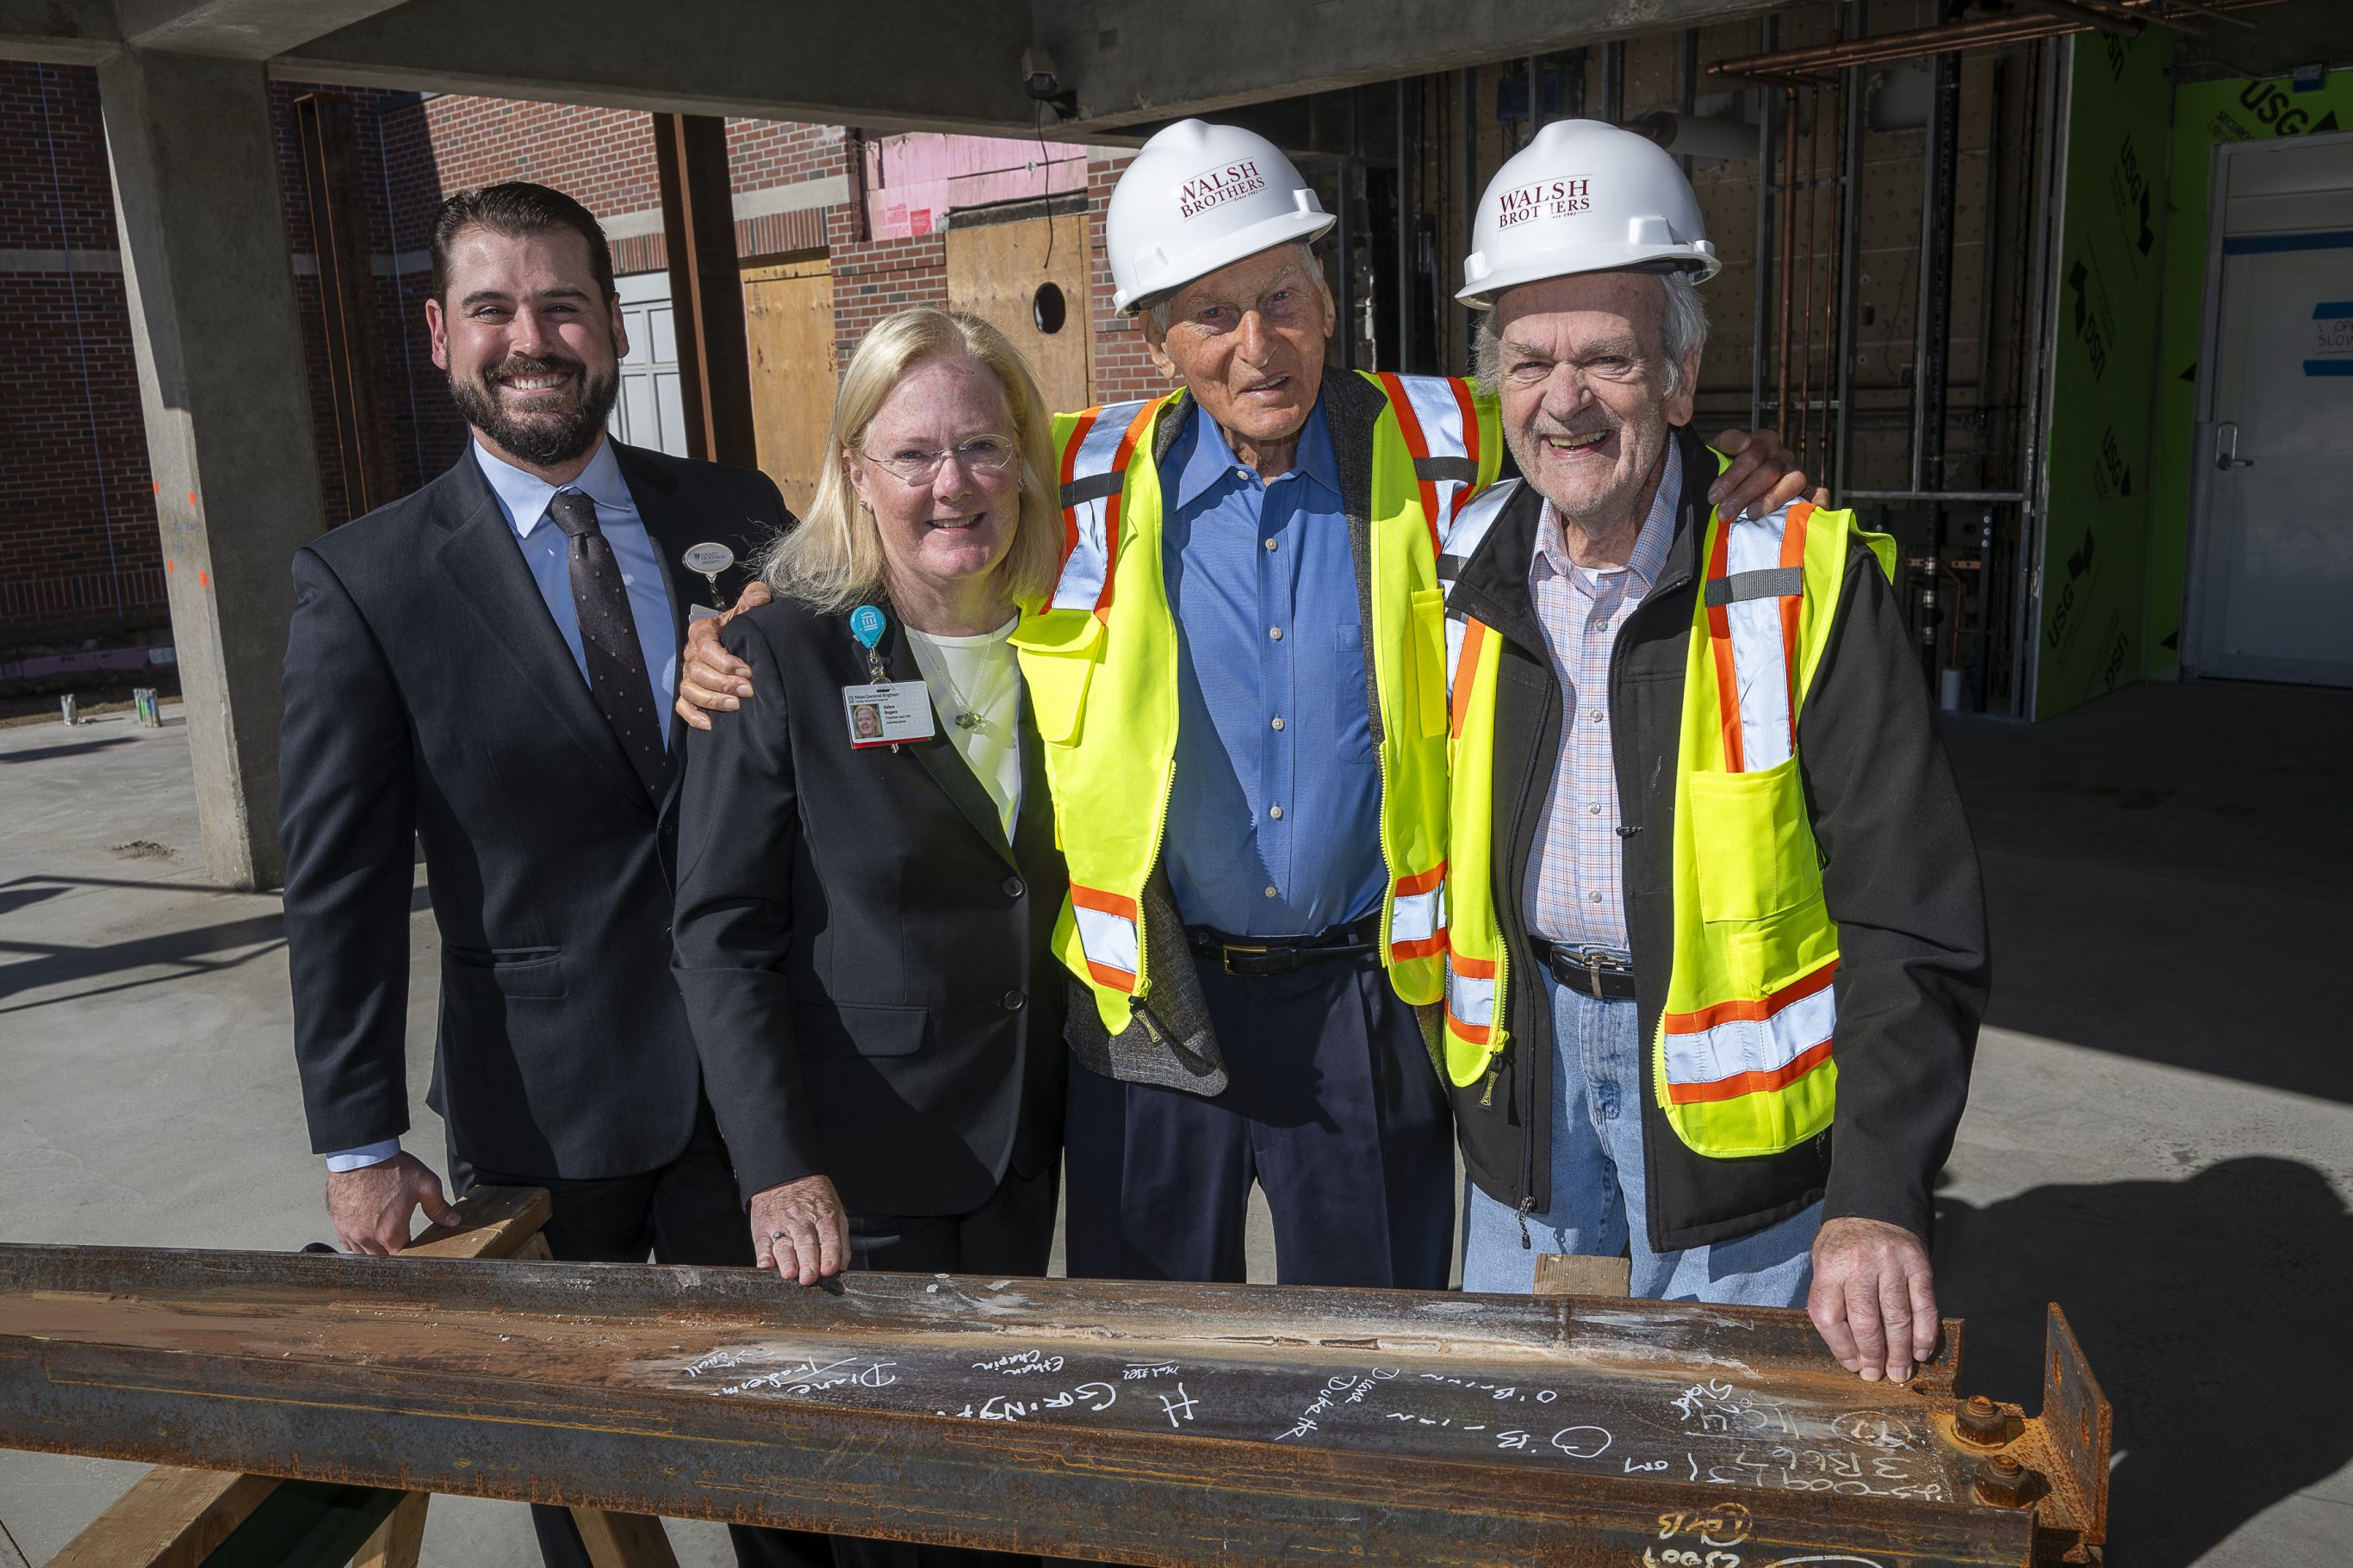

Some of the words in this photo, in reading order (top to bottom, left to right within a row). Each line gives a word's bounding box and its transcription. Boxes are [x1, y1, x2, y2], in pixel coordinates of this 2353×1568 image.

[1180, 161, 1259, 204] WALSH
[1180, 177, 1265, 218] BROTHERS
[1499, 179, 1590, 213] WALSH
[2120, 133, 2141, 204] USG
[2084, 312, 2107, 381] USG
[2102, 424, 2123, 488] USG
[2046, 582, 2075, 649] USG
[2105, 631, 2129, 689] USG
[1003, 1356, 1065, 1377] Ethan
